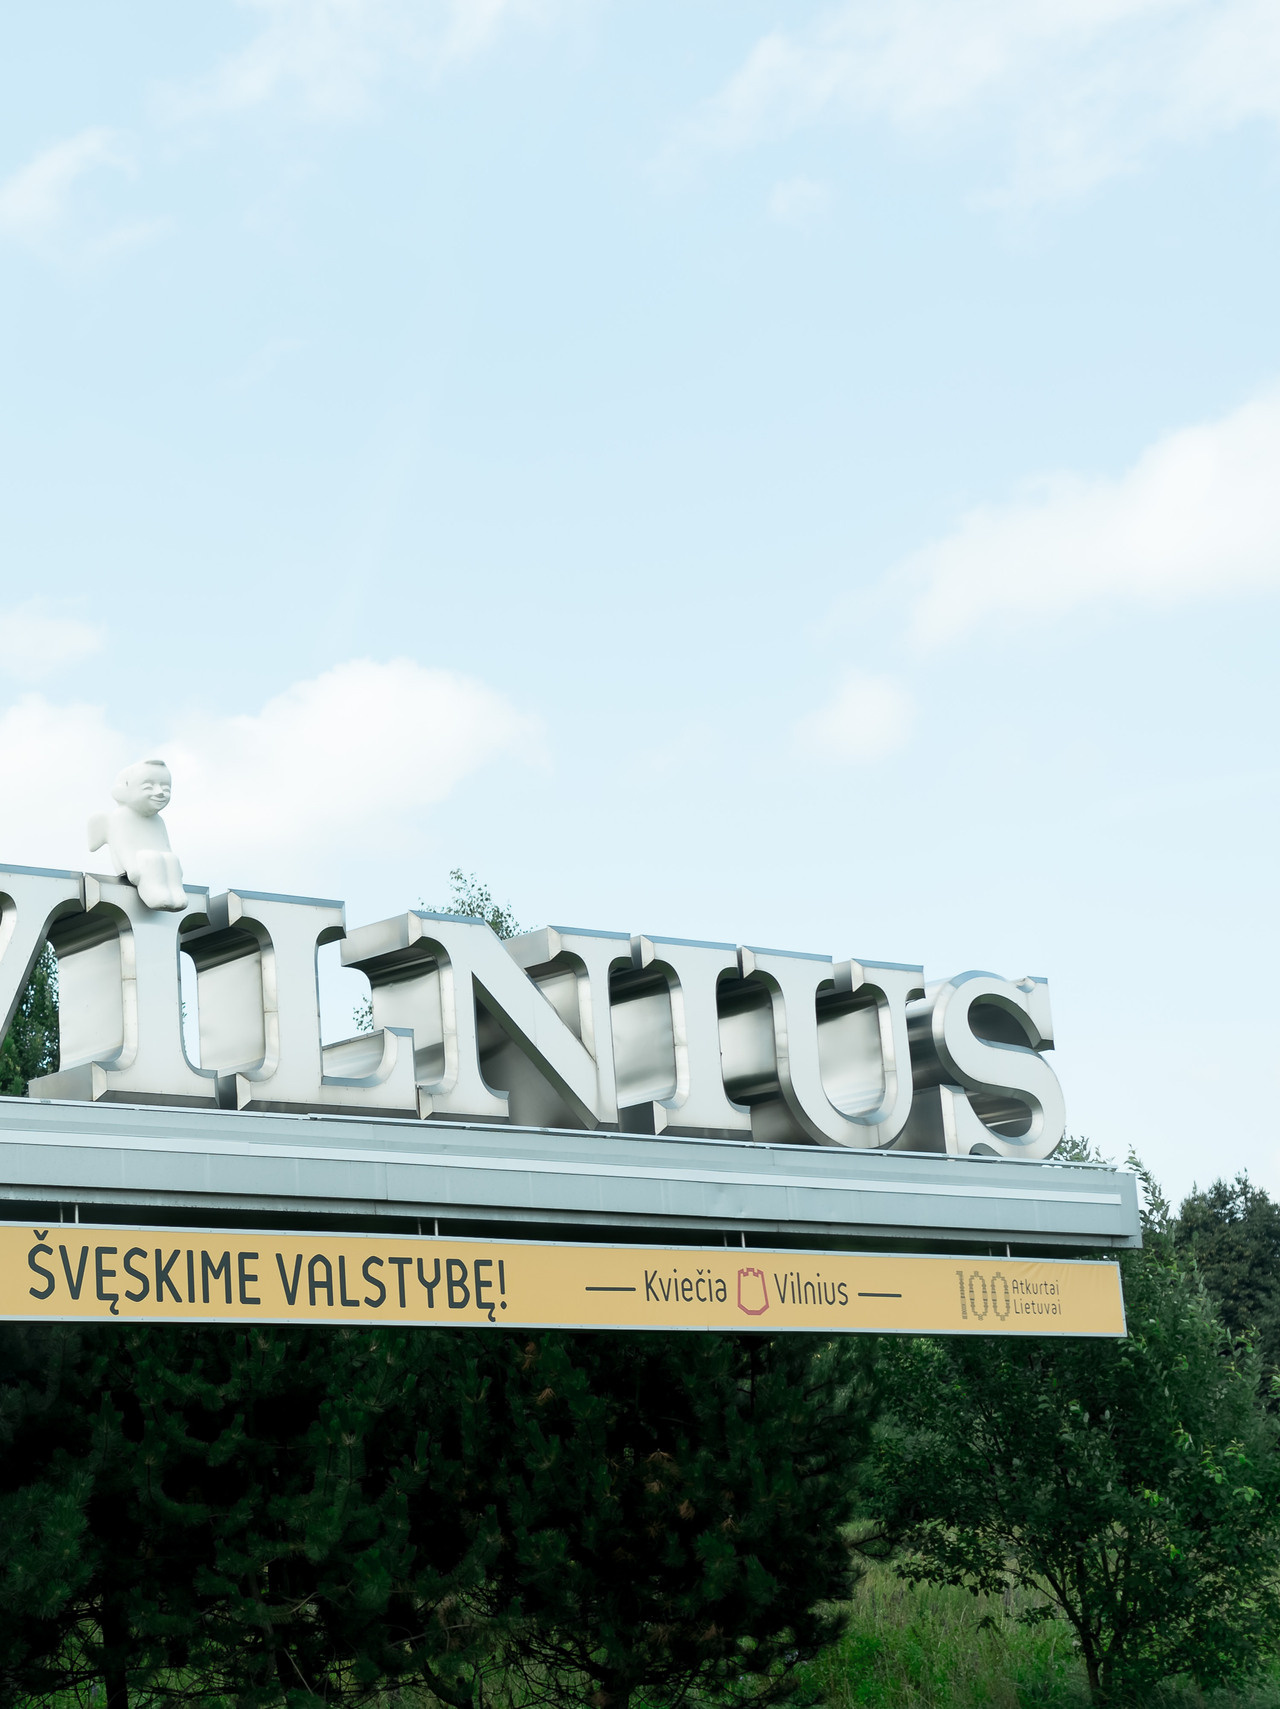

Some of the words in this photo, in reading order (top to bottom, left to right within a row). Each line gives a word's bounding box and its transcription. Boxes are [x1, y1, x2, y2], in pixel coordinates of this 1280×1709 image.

[27, 1229, 262, 1316] ŠVĘSKIME
[275, 1251, 508, 1323] VALSTYBĘ!
[644, 1268, 727, 1303] Kviečia
[773, 1271, 849, 1306] Vilnius
[1011, 1278, 1060, 1296] Atkurtai
[955, 1270, 1011, 1321] 100
[1013, 1298, 1062, 1316] Lietuvai
